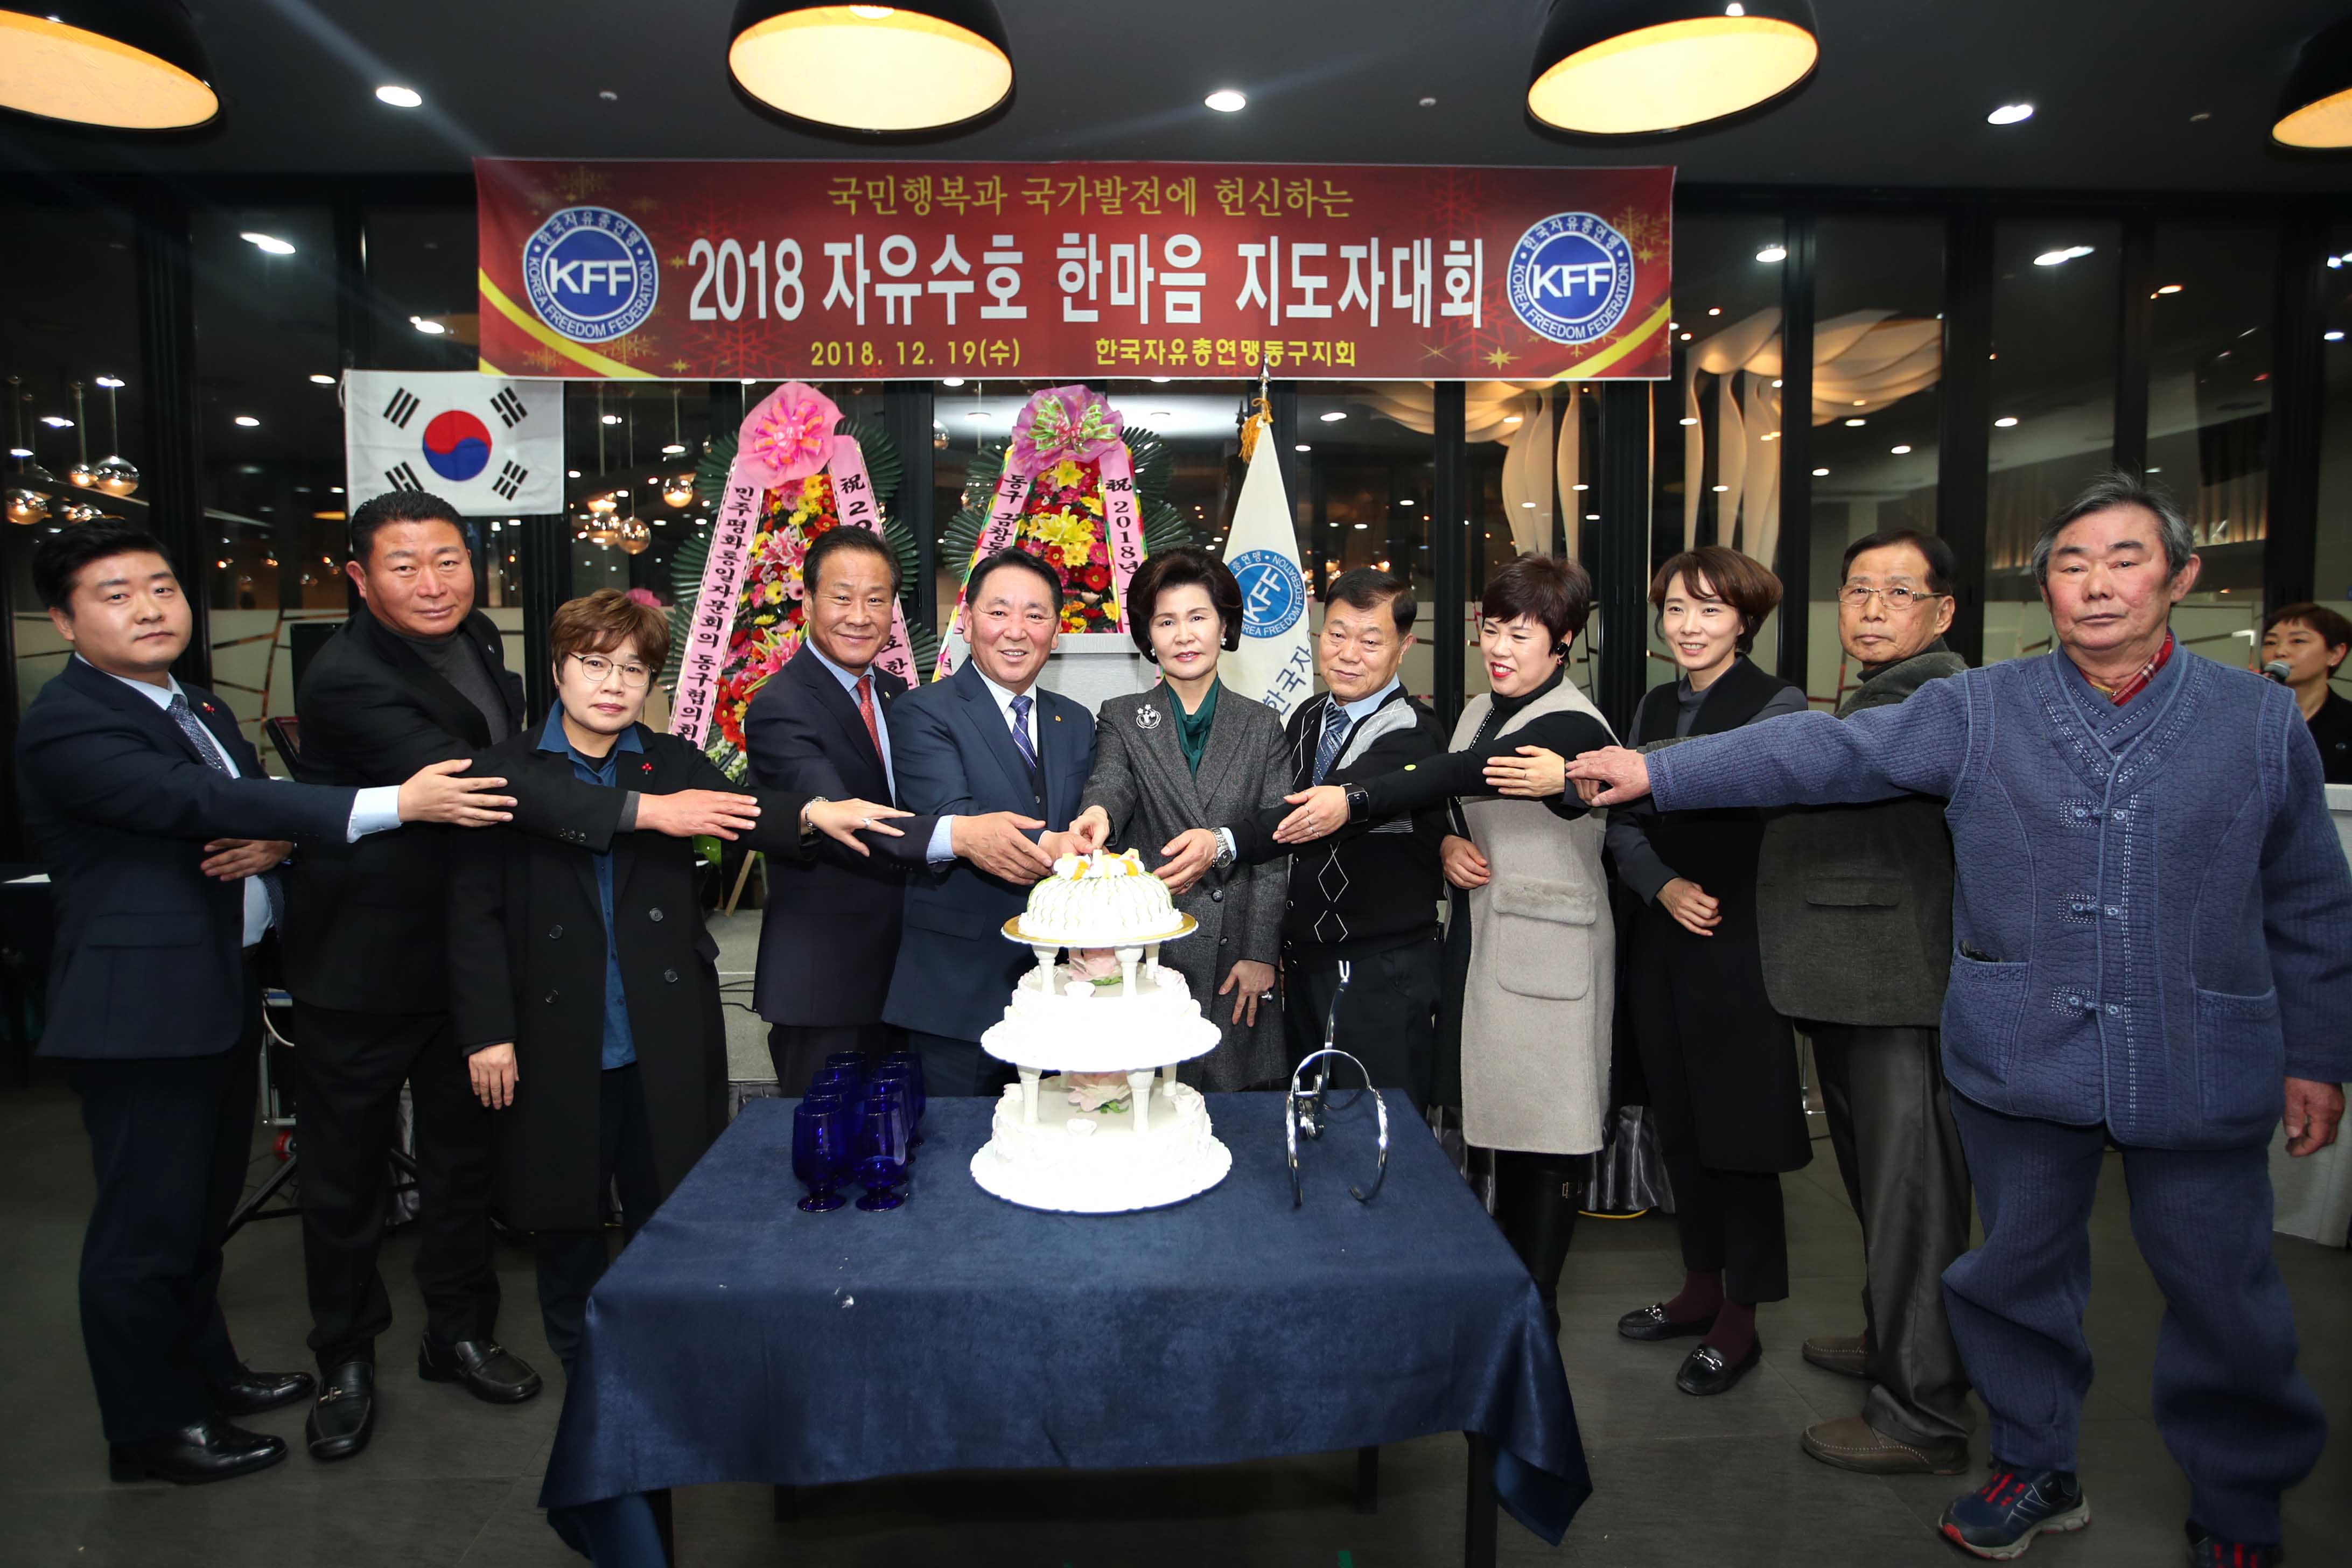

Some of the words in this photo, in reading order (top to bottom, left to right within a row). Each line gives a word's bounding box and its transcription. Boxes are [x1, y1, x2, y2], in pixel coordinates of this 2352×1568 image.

[828, 176, 1008, 216] 국민행복과
[1022, 176, 1196, 216] 국가발전에
[1215, 178, 1354, 218] 헌신하는
[538, 211, 641, 247] 한국자유총연맹
[1523, 216, 1621, 251] 한국자유총연맹
[549, 258, 632, 296] KFF
[688, 238, 804, 321] 2018
[822, 234, 1027, 325] 자유수호
[1056, 233, 1207, 325] 한마음
[1236, 236, 1483, 328] 지도자대회
[1532, 262, 1612, 299] KFF
[528, 256, 548, 308] KOREA
[544, 305, 607, 338] FREEDOM
[609, 260, 653, 334] FEDERATION
[1512, 264, 1530, 312] KOREA
[1525, 309, 1586, 339] FREEDOM
[1588, 262, 1629, 336] FEDERATION
[811, 341, 883, 366] 2018.
[897, 341, 934, 365] 12.
[948, 338, 1020, 367] 19(수)
[1095, 338, 1356, 367] 한국자유총연맹동구지회
[840, 474, 865, 494] 祝
[999, 474, 1027, 503] 동구
[1105, 478, 1132, 492] 祝
[1114, 501, 1139, 575] 2018년
[697, 486, 754, 648] 민주평화통일자문회의
[1272, 555, 1303, 606] FEDERATION
[1244, 566, 1281, 622] KFF
[1264, 606, 1301, 636] FREEDOM
[676, 654, 717, 739] 동구협의회
